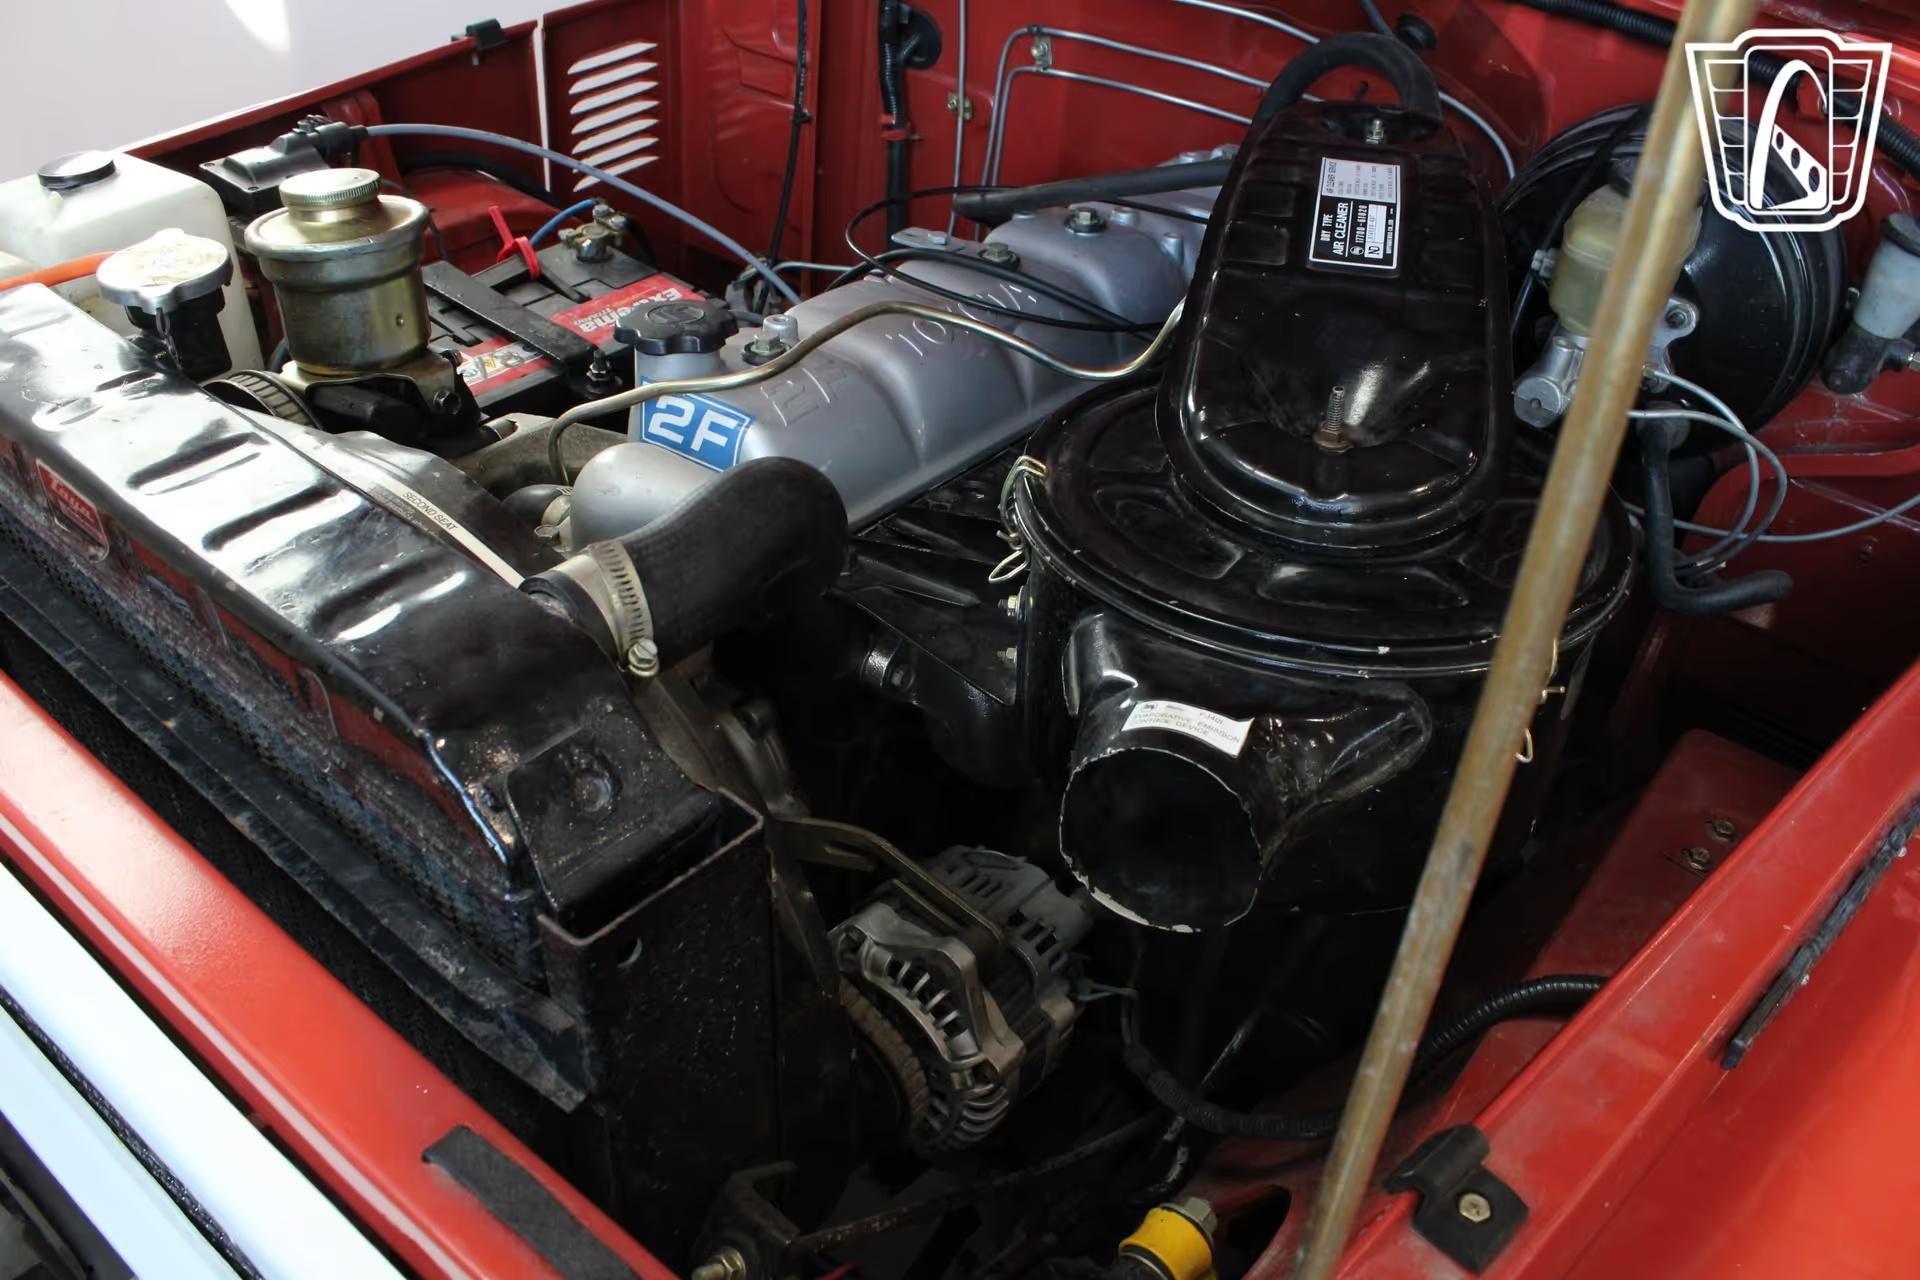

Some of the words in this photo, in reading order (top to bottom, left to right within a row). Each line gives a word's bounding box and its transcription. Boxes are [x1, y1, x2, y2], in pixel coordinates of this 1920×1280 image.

[1322, 213, 1333, 227] TYPE
[1335, 202, 1348, 239] CLEANER
[1320, 230, 1331, 241] DRY
[1332, 241, 1345, 255] AIR
[647, 394, 739, 452] 2F
[403, 492, 437, 516] SECOND
[434, 514, 458, 530] SEAT
[1175, 720, 1210, 736] DEVICE
